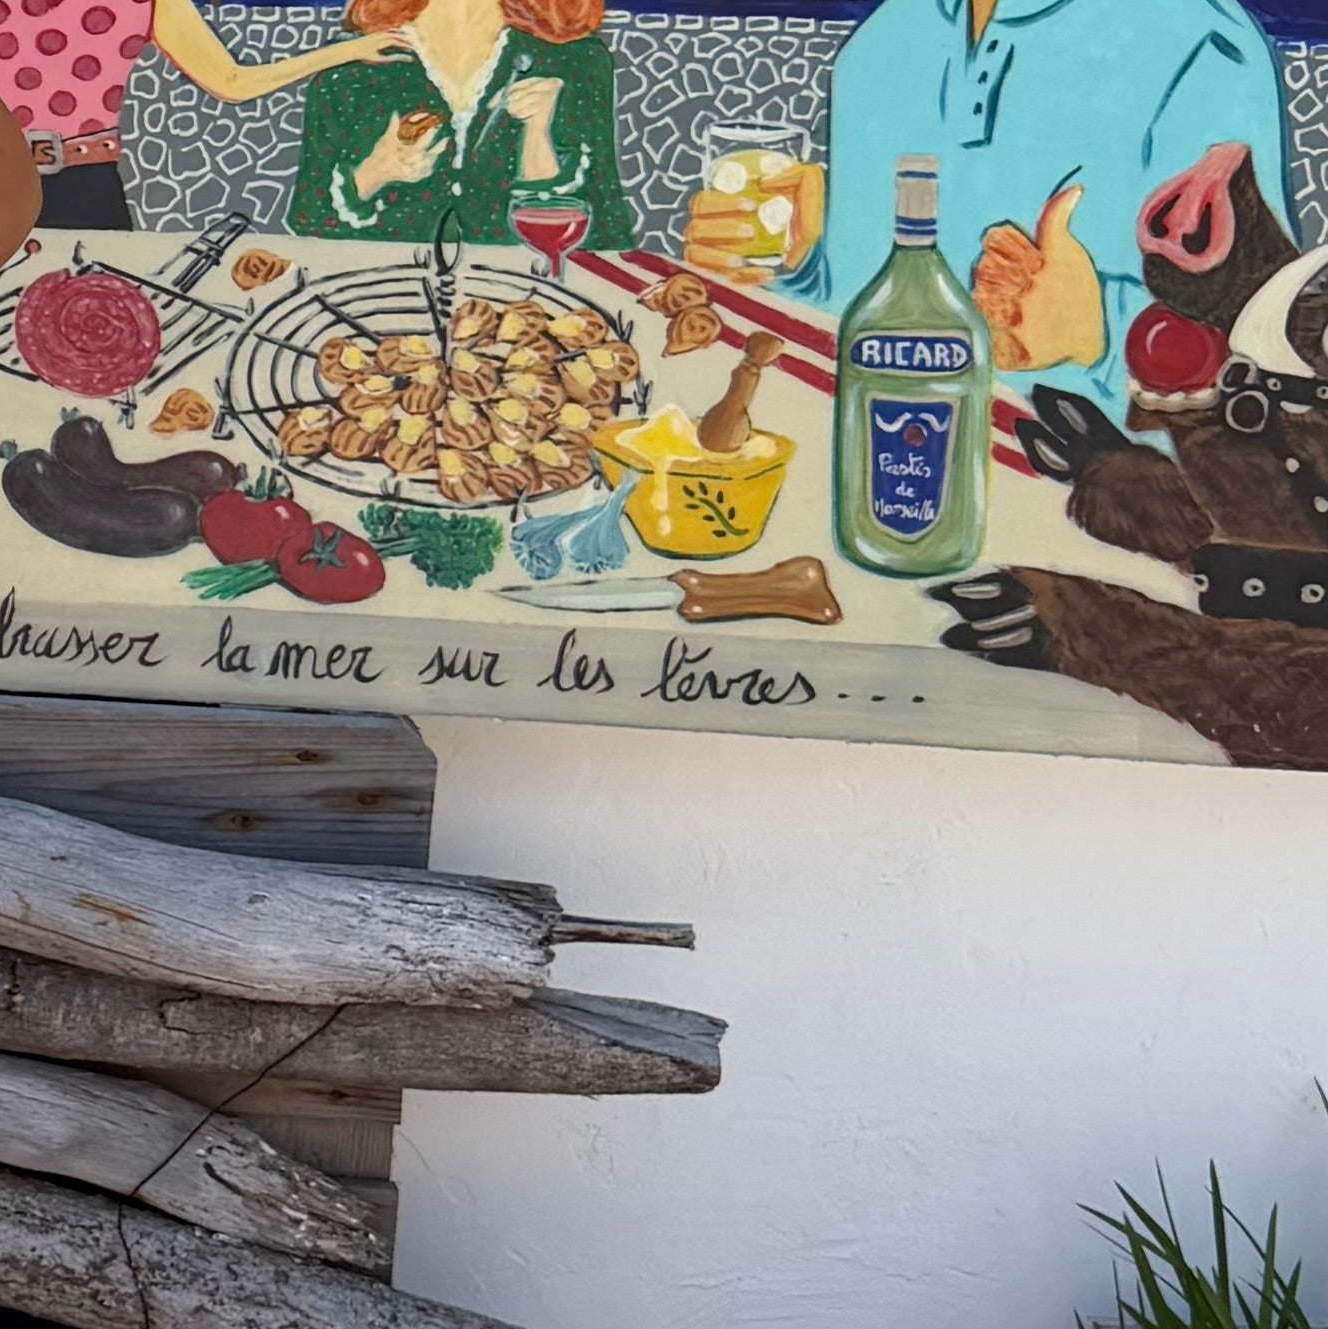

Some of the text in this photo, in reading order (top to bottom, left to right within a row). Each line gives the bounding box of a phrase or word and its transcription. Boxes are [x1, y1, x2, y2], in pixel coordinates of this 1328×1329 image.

[861, 339, 968, 369] RICARD
[878, 452, 931, 478] Pastis
[895, 483, 916, 497] de
[200, 615, 256, 673] la
[264, 640, 387, 683] mer
[418, 645, 509, 687] sur
[537, 628, 615, 693] les
